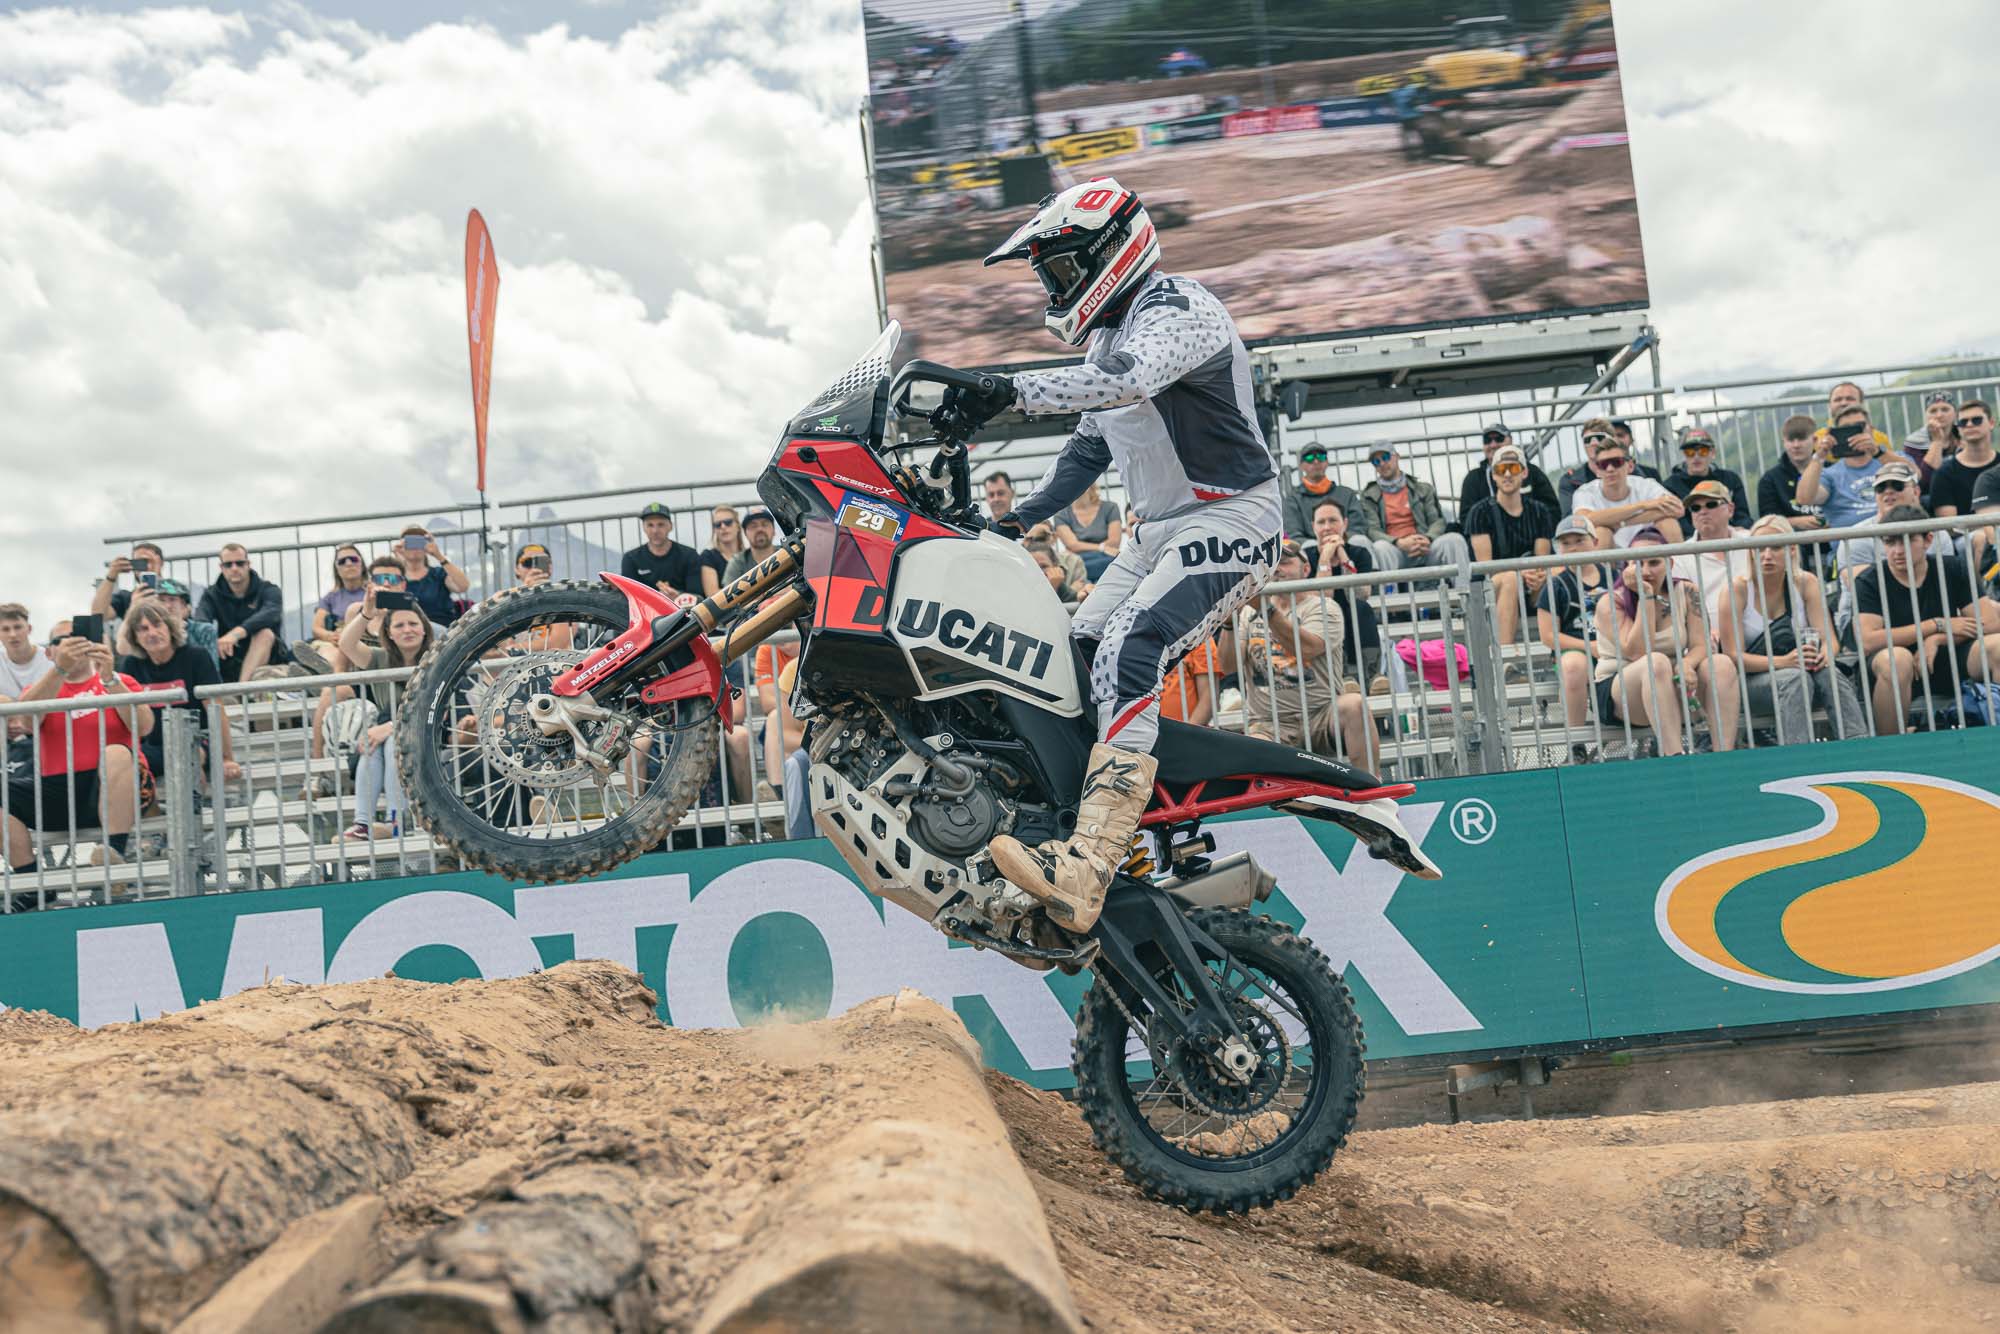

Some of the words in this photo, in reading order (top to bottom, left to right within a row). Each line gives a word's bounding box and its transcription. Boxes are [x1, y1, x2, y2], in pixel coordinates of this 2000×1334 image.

[1087, 220, 1120, 256] DUCATI
[1081, 272, 1118, 317] DUCATI
[833, 473, 896, 496] DESERTX
[855, 510, 885, 531] 29
[1178, 531, 1281, 568] DUCATI
[723, 555, 780, 603] KYB
[852, 585, 1054, 680] DUCATI
[570, 647, 625, 687] METZELER
[1296, 752, 1351, 774] DESERTX
[76, 801, 1485, 1070] MOTORX
